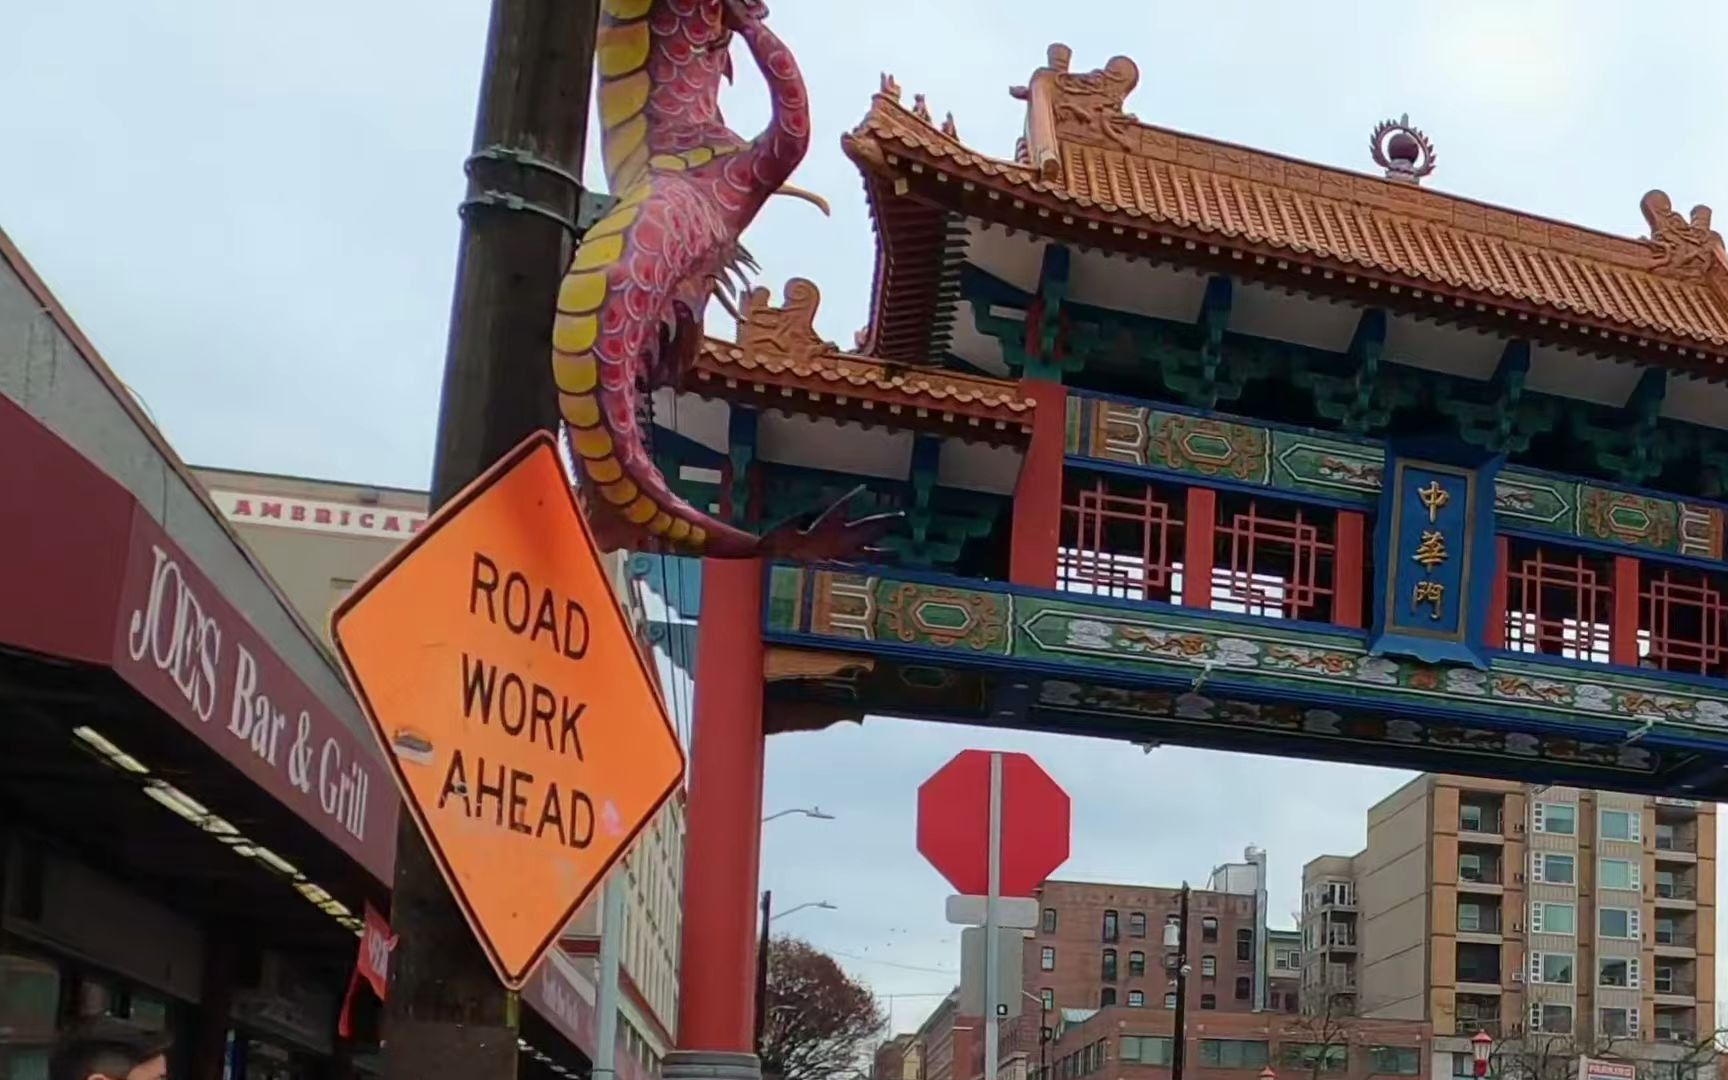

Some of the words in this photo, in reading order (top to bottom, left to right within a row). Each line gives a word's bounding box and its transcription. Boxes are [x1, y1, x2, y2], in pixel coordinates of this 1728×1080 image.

[470, 551, 590, 661] ROAD
[1411, 481, 1450, 622] 中華門
[227, 643, 285, 767] Bar
[288, 710, 314, 794] &
[320, 737, 368, 841] Grill
[462, 652, 587, 763] WORK
[438, 749, 595, 850] AHEAD
